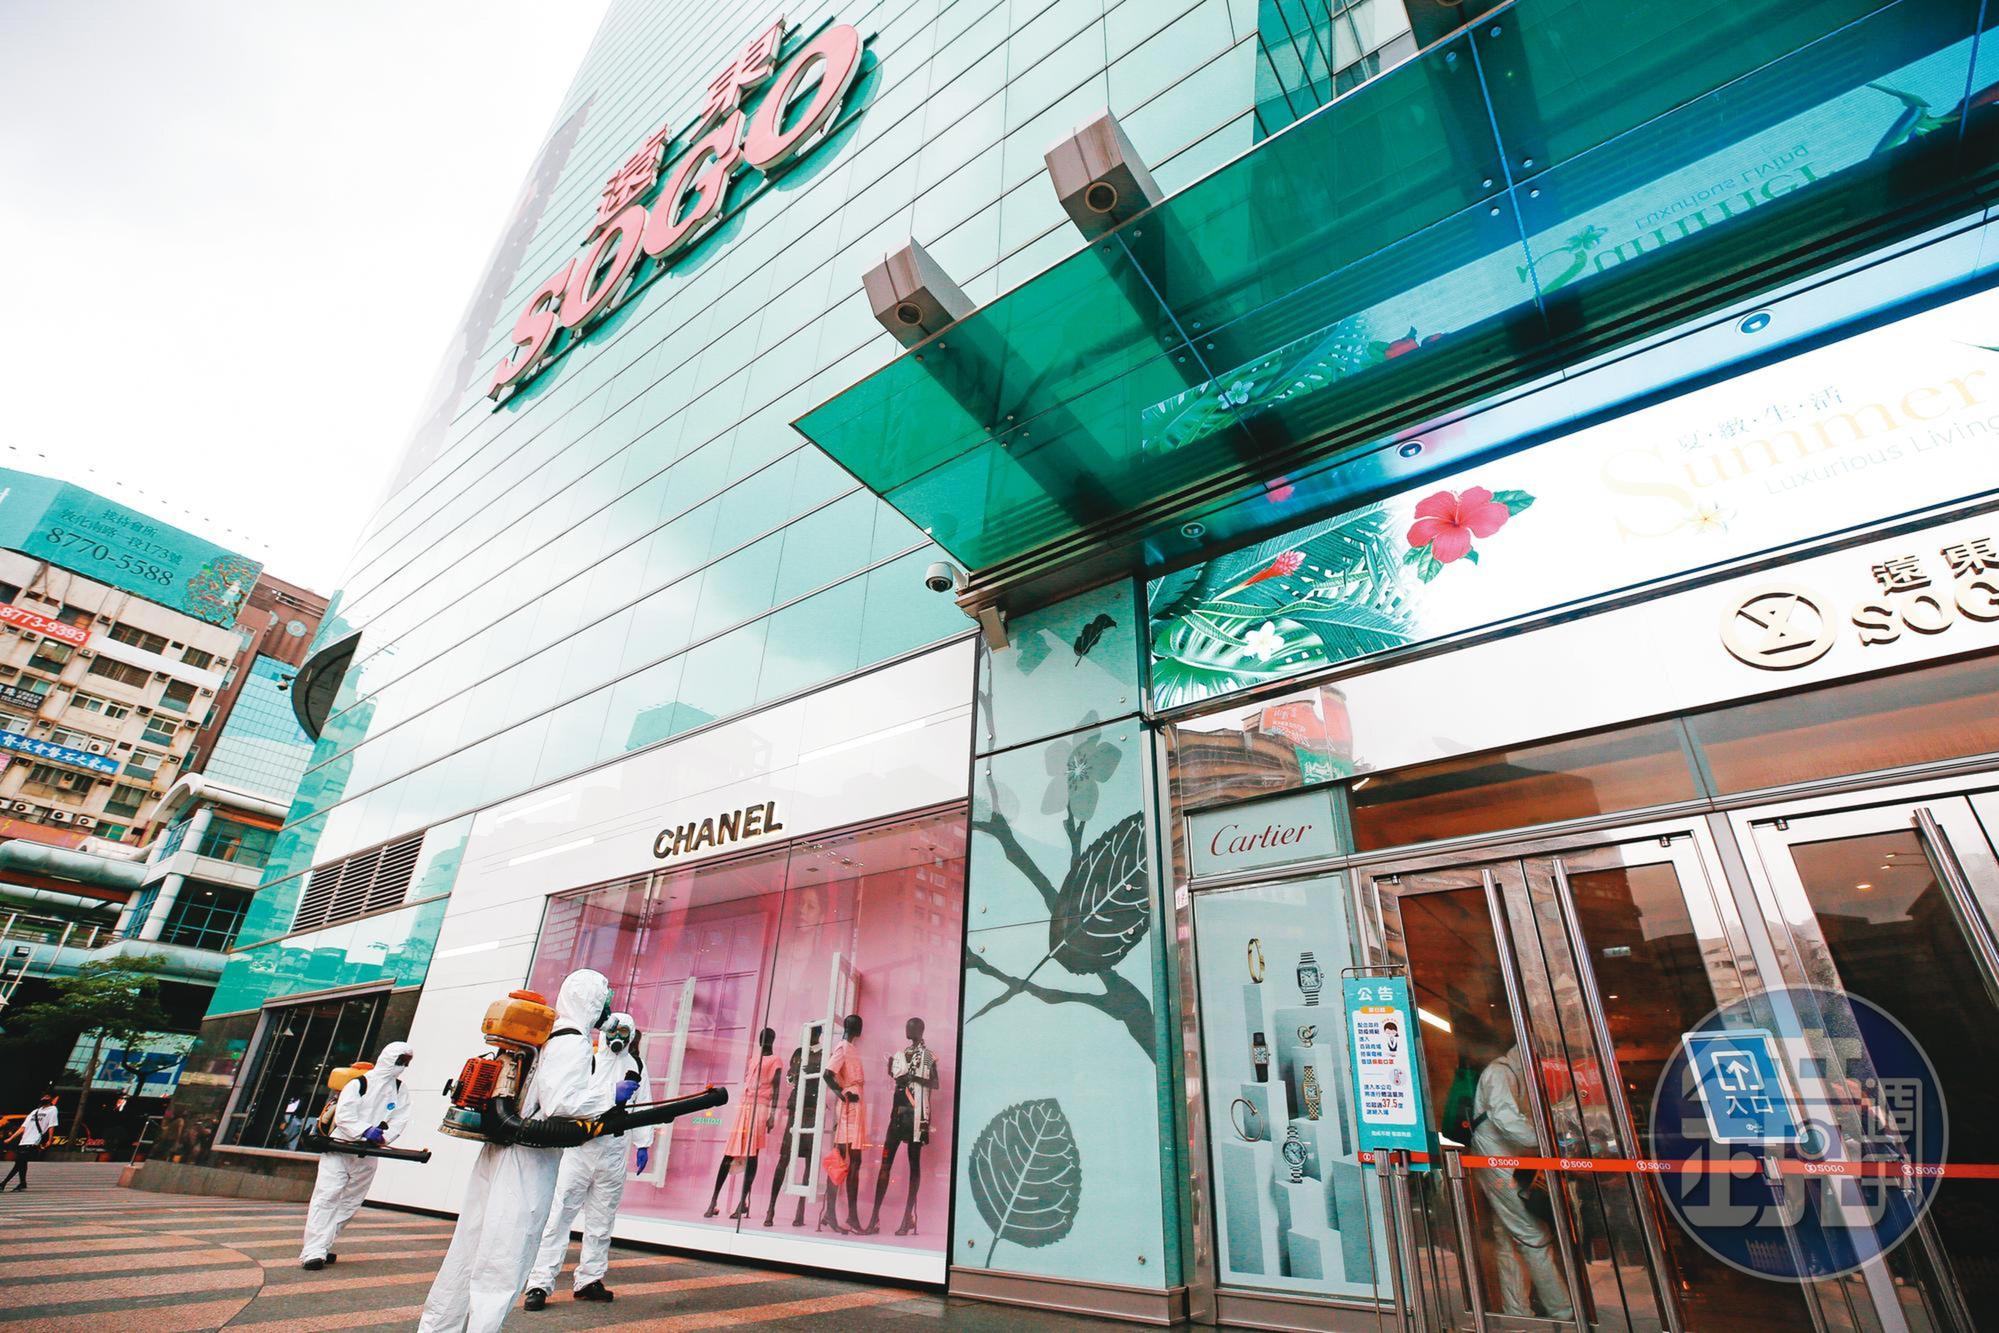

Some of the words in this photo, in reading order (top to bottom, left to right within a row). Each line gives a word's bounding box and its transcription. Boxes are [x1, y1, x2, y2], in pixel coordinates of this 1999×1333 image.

[581, 13, 788, 247] 遠東
[487, 24, 863, 401] SOGO
[1600, 368, 1987, 543] Summer
[1764, 443, 1904, 496] Luxurious
[46, 527, 173, 586] 8770-5588
[1871, 536, 1999, 598] 遠東
[0, 607, 87, 641] 8773-9393
[653, 801, 783, 859] CHANEL
[1210, 824, 1313, 856] Cartier
[1357, 986, 1393, 1001] 公告
[1725, 1096, 1774, 1115] 入口
[1570, 1160, 1593, 1168] SOGO
[1647, 1162, 1671, 1170] SOGO
[1817, 1164, 1845, 1173] SOGO
[1915, 1166, 1945, 1175] SOGO
